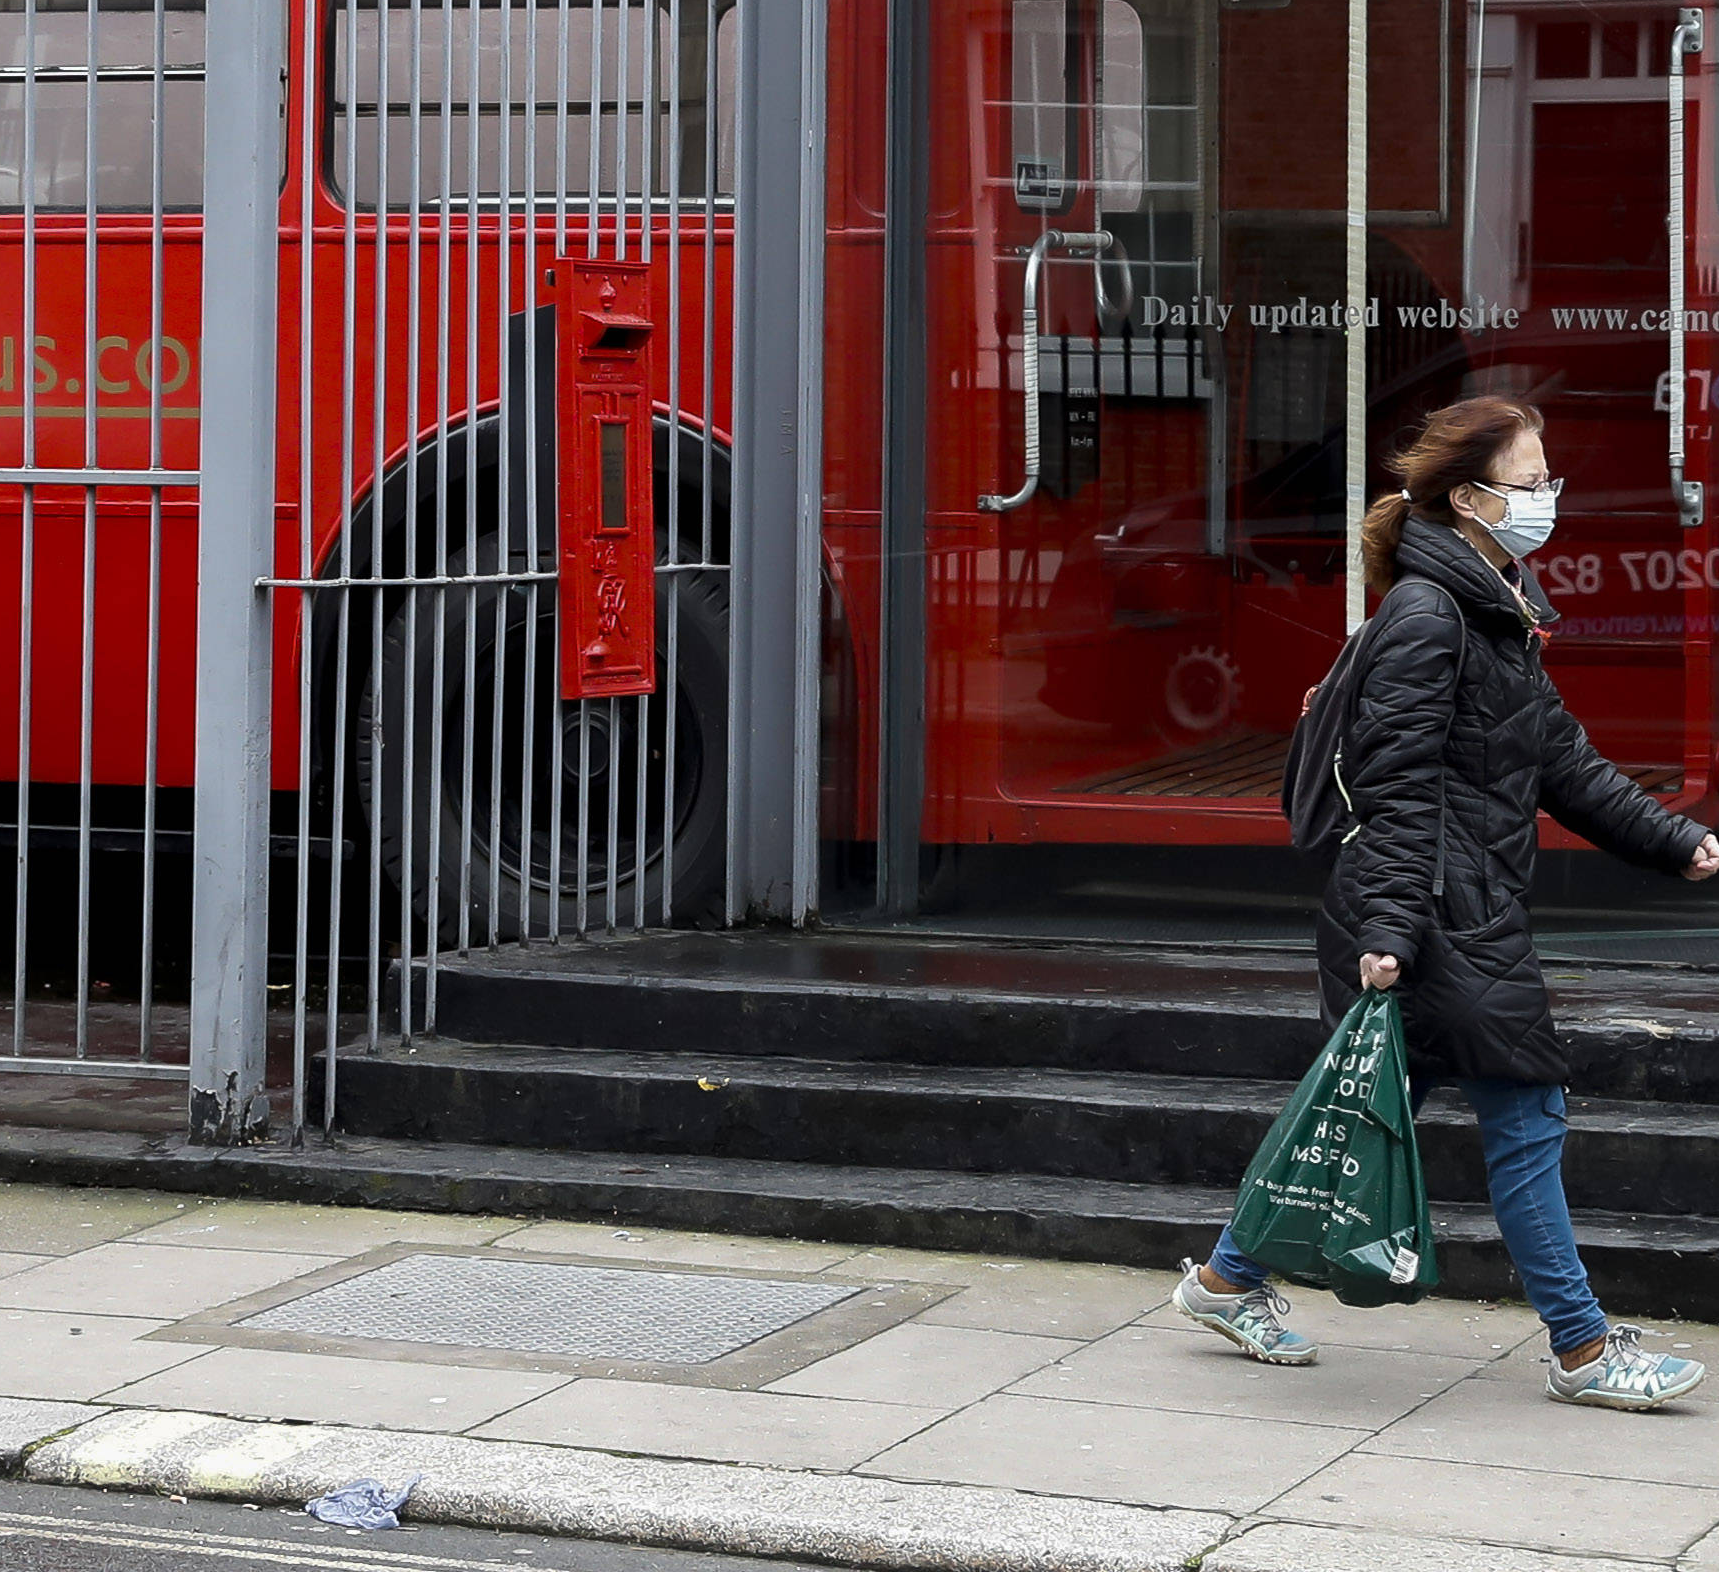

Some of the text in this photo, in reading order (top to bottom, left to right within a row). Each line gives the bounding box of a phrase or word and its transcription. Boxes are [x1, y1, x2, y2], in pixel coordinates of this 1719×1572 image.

[1141, 295, 1234, 332] Daily
[1249, 296, 1381, 334] updated
[1396, 298, 1520, 330] website
